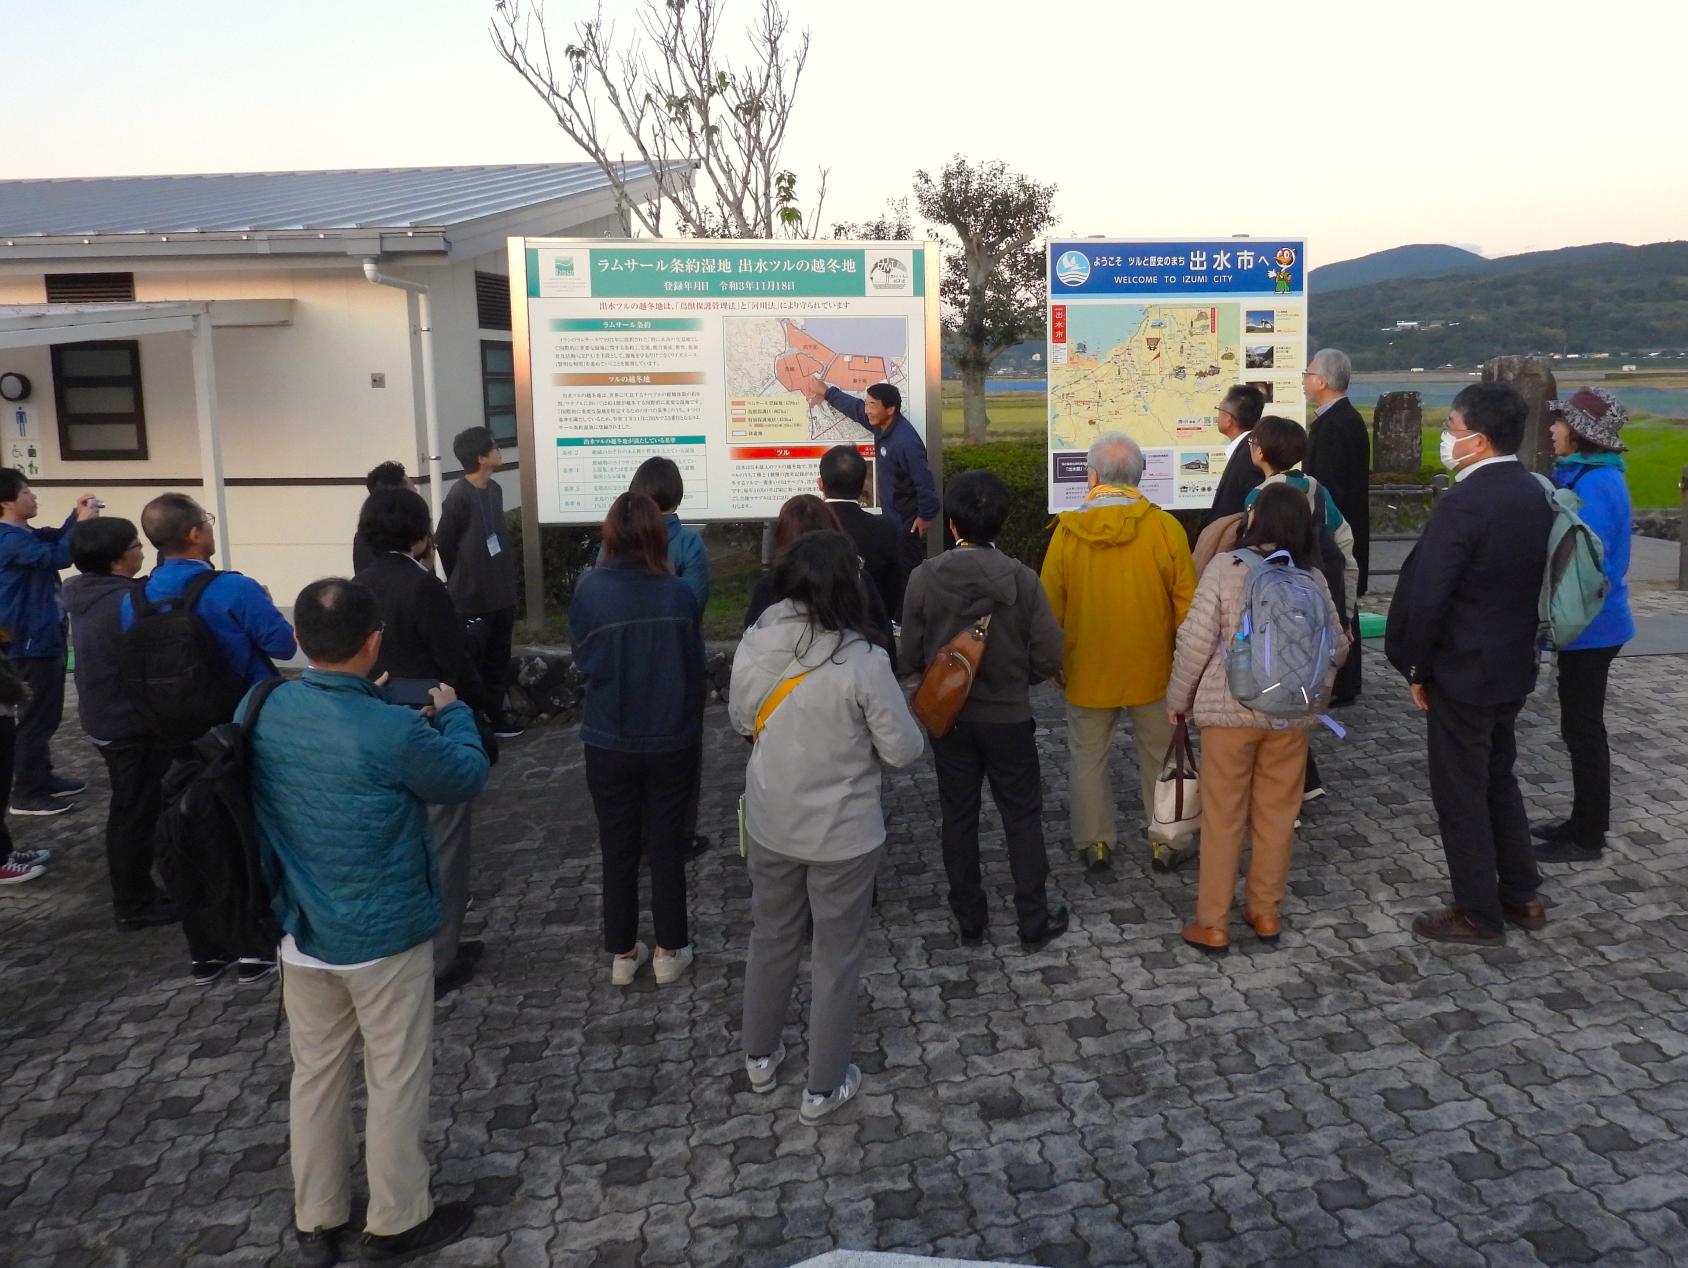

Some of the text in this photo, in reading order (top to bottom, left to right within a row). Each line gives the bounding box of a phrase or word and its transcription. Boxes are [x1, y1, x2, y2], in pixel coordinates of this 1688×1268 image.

[598, 258, 857, 274] ラムサール条約湿地 出水ツルの越冬地
[1093, 250, 1270, 271] ようこそ ツルと歴史のまち 出水市へ
[1114, 275, 1233, 284] WELCOME TO IZUMI CITY
[664, 280, 795, 291] 登録年月日 令和3年11月18日
[602, 321, 651, 329] ラムサール条約
[1055, 311, 1064, 338] 出水市
[608, 375, 651, 383] ツルの越冬地
